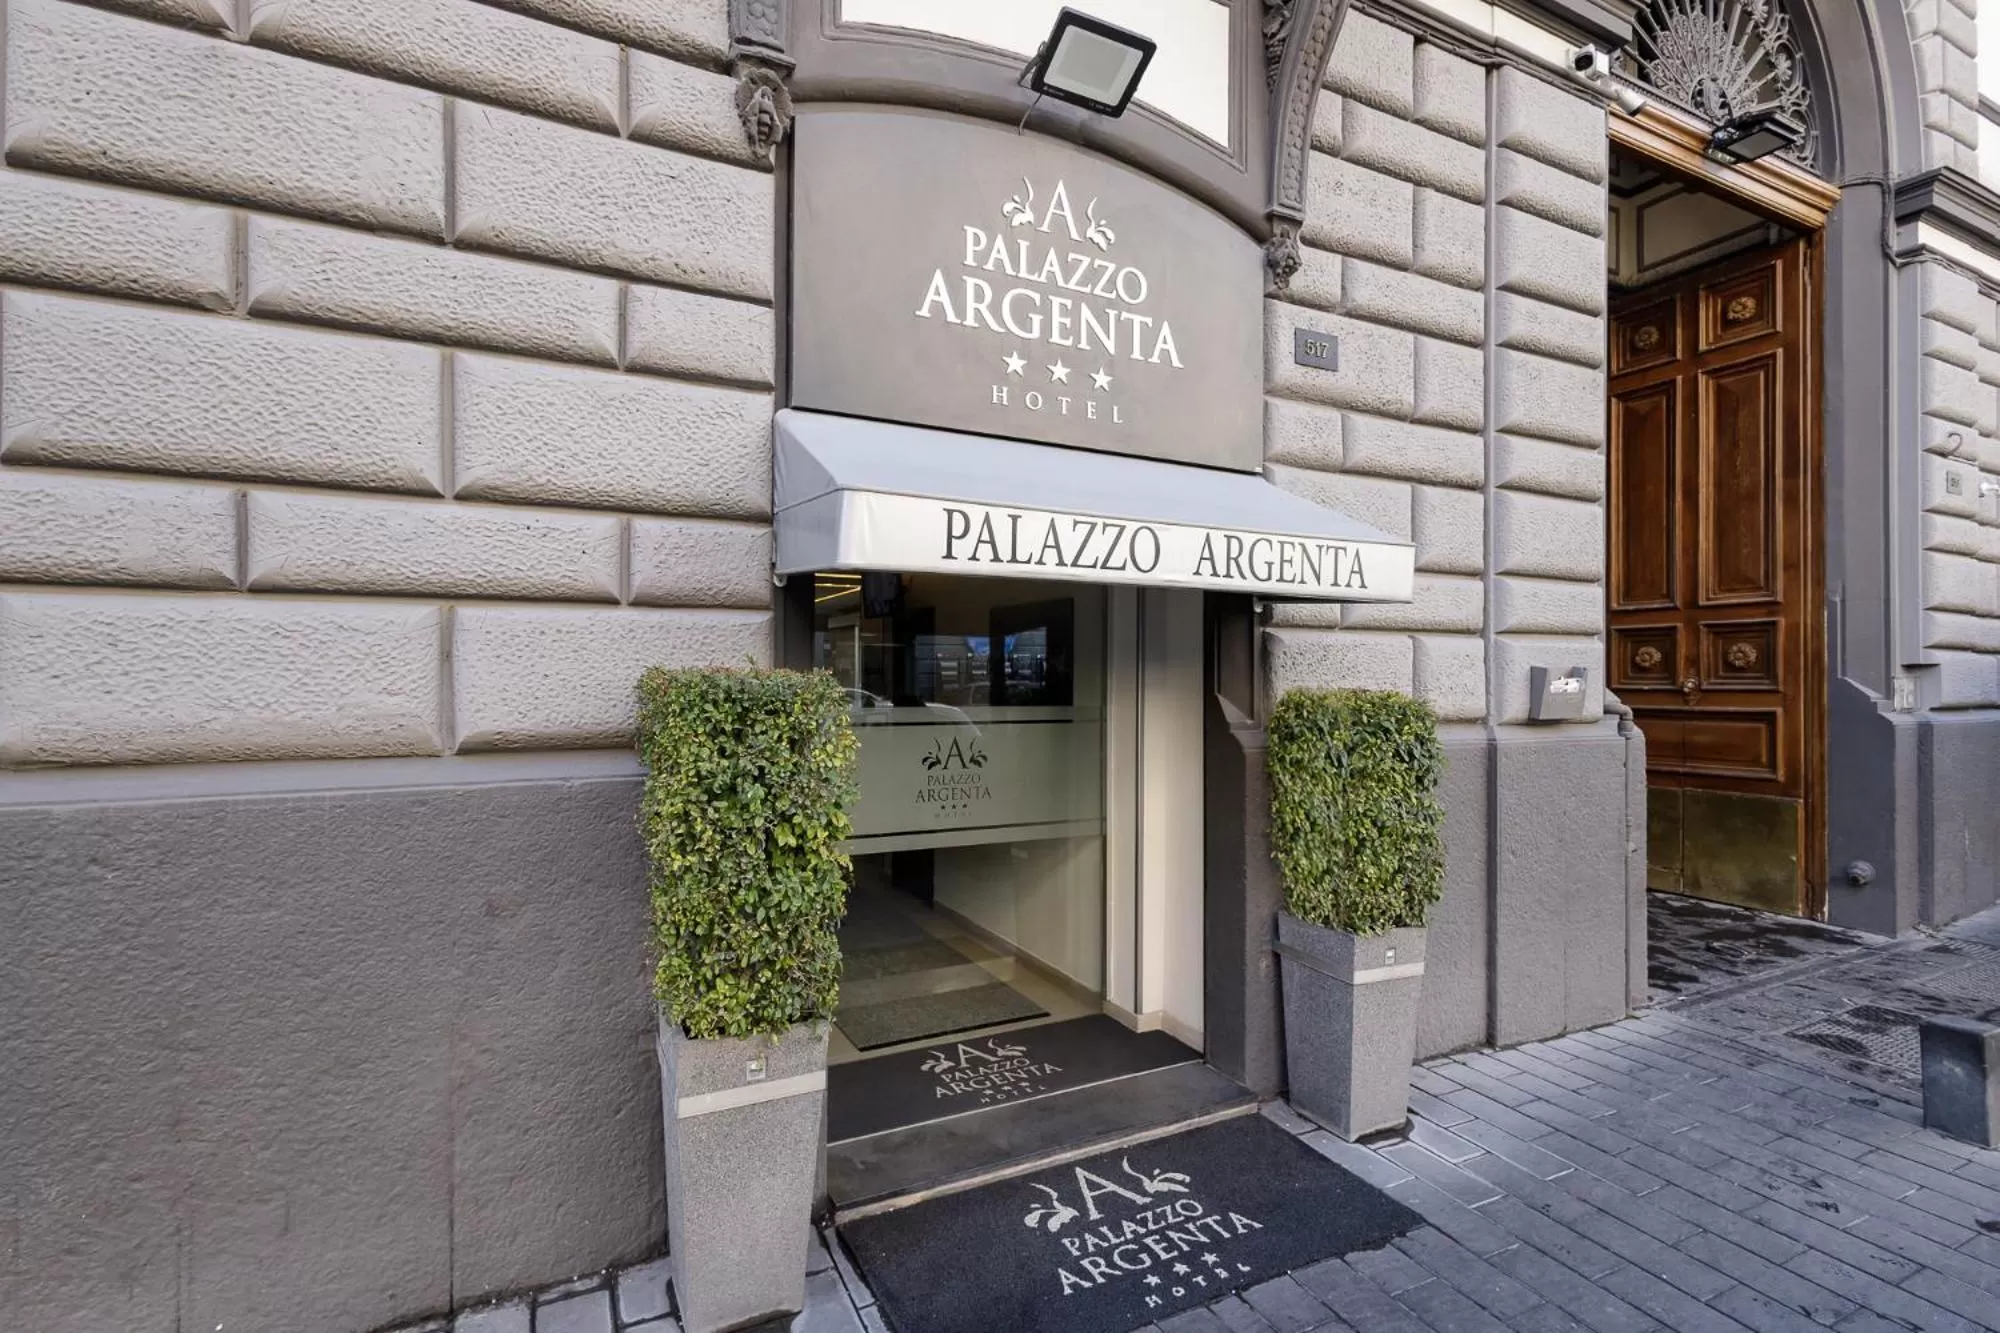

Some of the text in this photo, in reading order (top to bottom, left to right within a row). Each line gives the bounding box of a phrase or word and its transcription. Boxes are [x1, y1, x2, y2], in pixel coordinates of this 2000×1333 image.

[1038, 178, 1085, 242] A
[961, 224, 1148, 305] PALAZZO
[915, 268, 1185, 370] ARGENTA
[991, 384, 1125, 426] HOTEL
[941, 506, 1369, 590] PALAZZO ARGENTA
[915, 785, 992, 804] ARGENTA
[927, 774, 982, 786] PALAZZO
[935, 1063, 1064, 1099] ARGENTA
[940, 1057, 1031, 1083] PALAZZO
[1061, 1199, 1204, 1257] PALAZZO
[1057, 1212, 1265, 1296] ARGENTA
[1145, 1263, 1252, 1308] HOTEL
